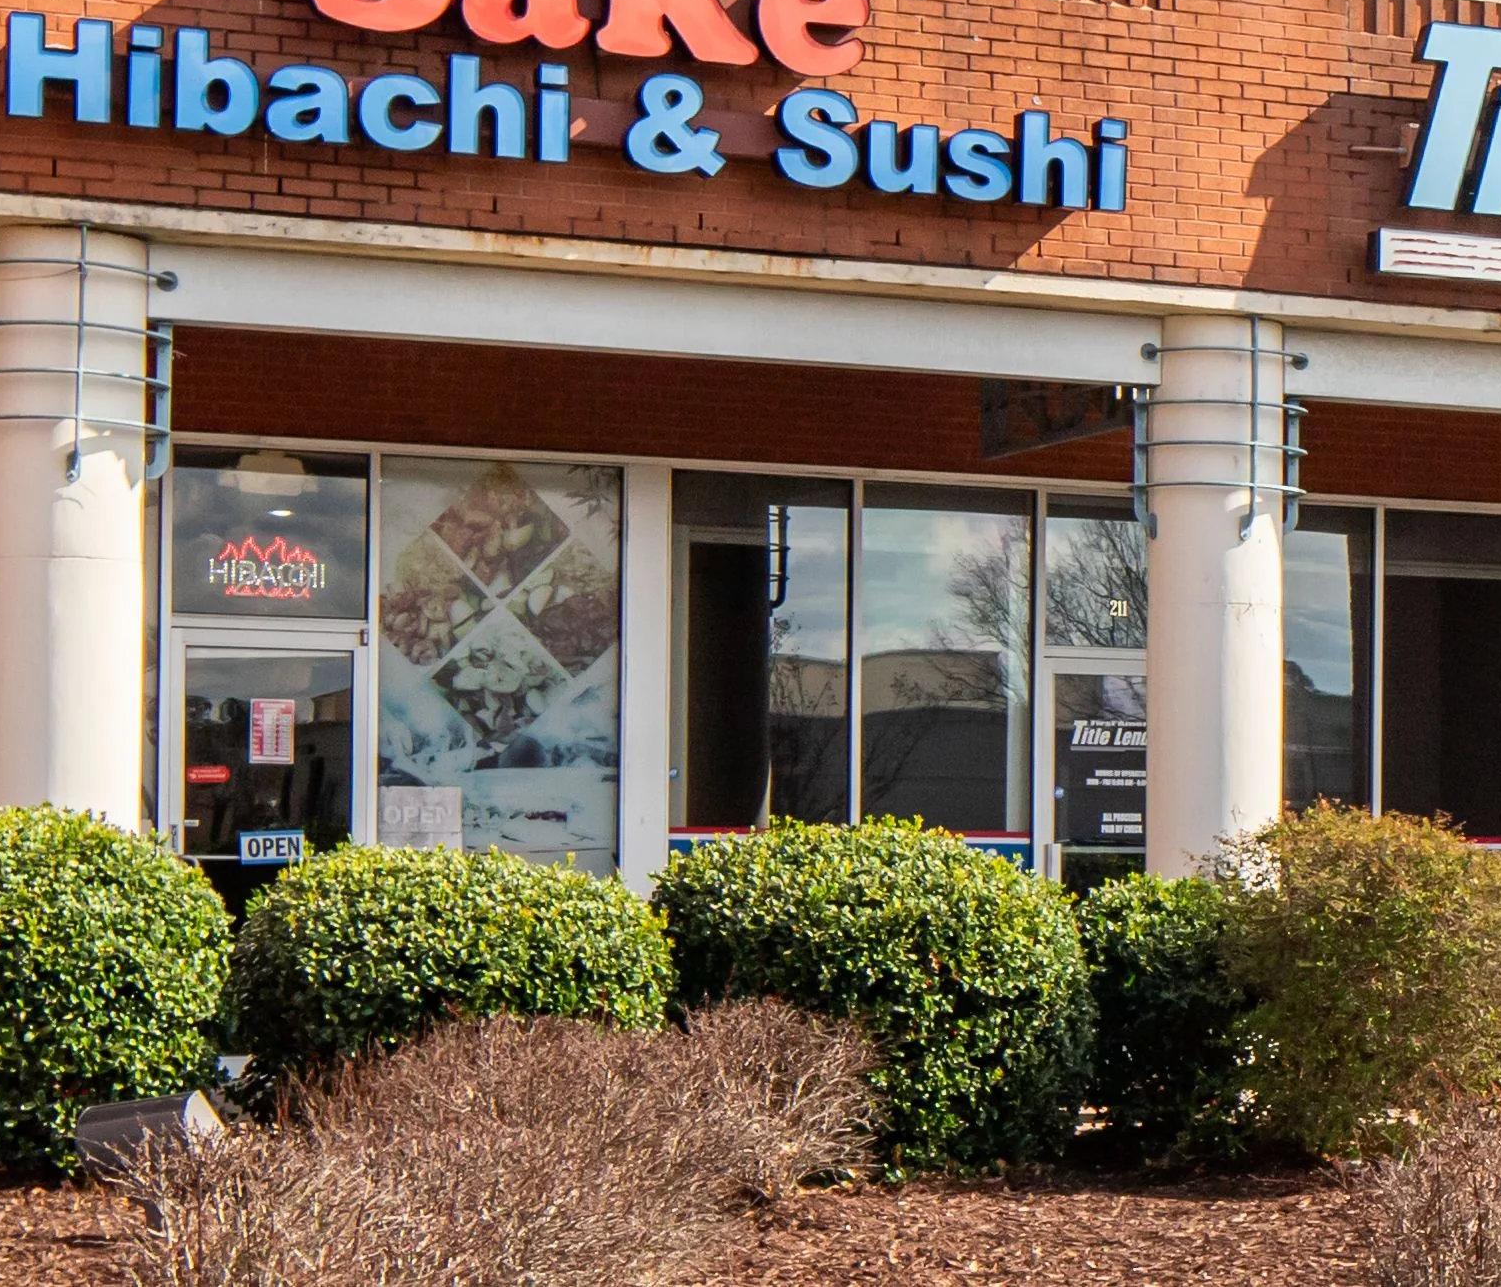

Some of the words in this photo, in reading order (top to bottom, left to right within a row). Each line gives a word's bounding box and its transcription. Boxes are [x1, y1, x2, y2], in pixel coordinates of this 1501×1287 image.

[5, 10, 570, 166] Hibachi
[625, 73, 726, 179] &
[774, 88, 1128, 213] Sushi
[209, 558, 325, 589] HIBACHI
[1110, 600, 1128, 617] 211
[1072, 720, 1111, 745] Title
[248, 837, 300, 857] OPEN
